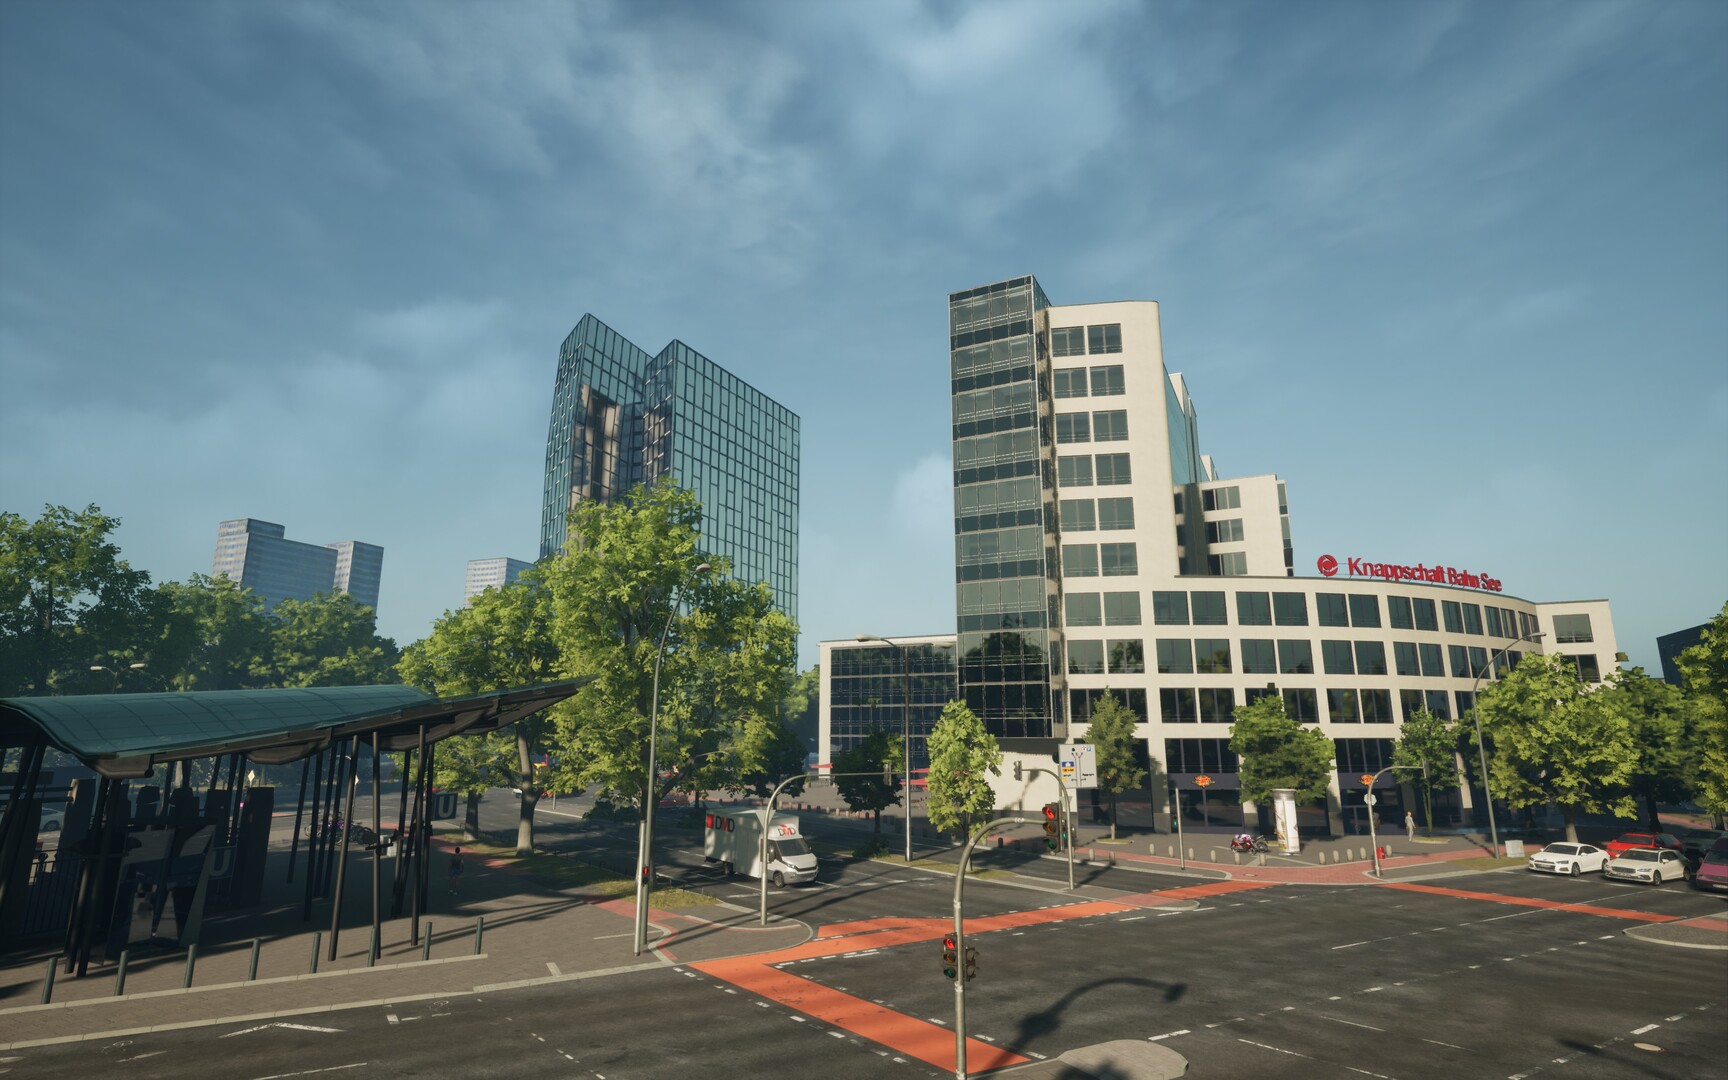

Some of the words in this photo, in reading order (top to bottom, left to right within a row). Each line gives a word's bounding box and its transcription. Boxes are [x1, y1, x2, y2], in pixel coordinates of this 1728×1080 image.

[1347, 557, 1446, 583] Knappschaft
[1447, 567, 1480, 588] Bahn
[1480, 572, 1503, 592] See
[438, 795, 455, 819] U
